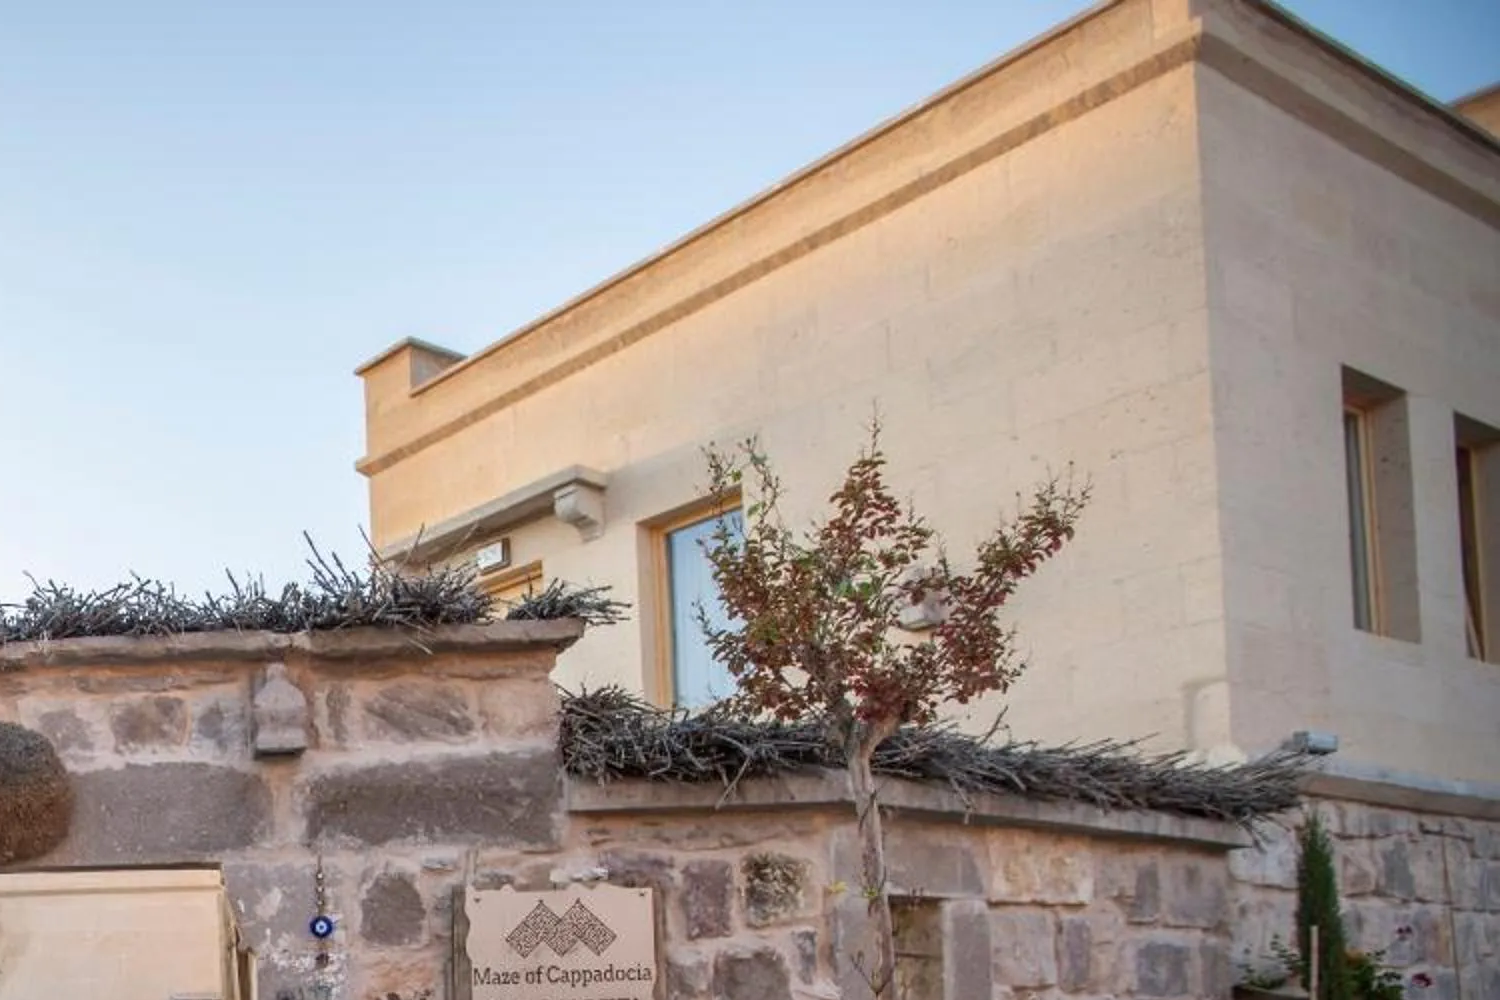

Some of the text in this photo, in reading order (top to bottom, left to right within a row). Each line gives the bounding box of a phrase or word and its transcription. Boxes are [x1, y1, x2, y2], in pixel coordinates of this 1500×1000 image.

[473, 964, 652, 988] Maze of Cappadocia
